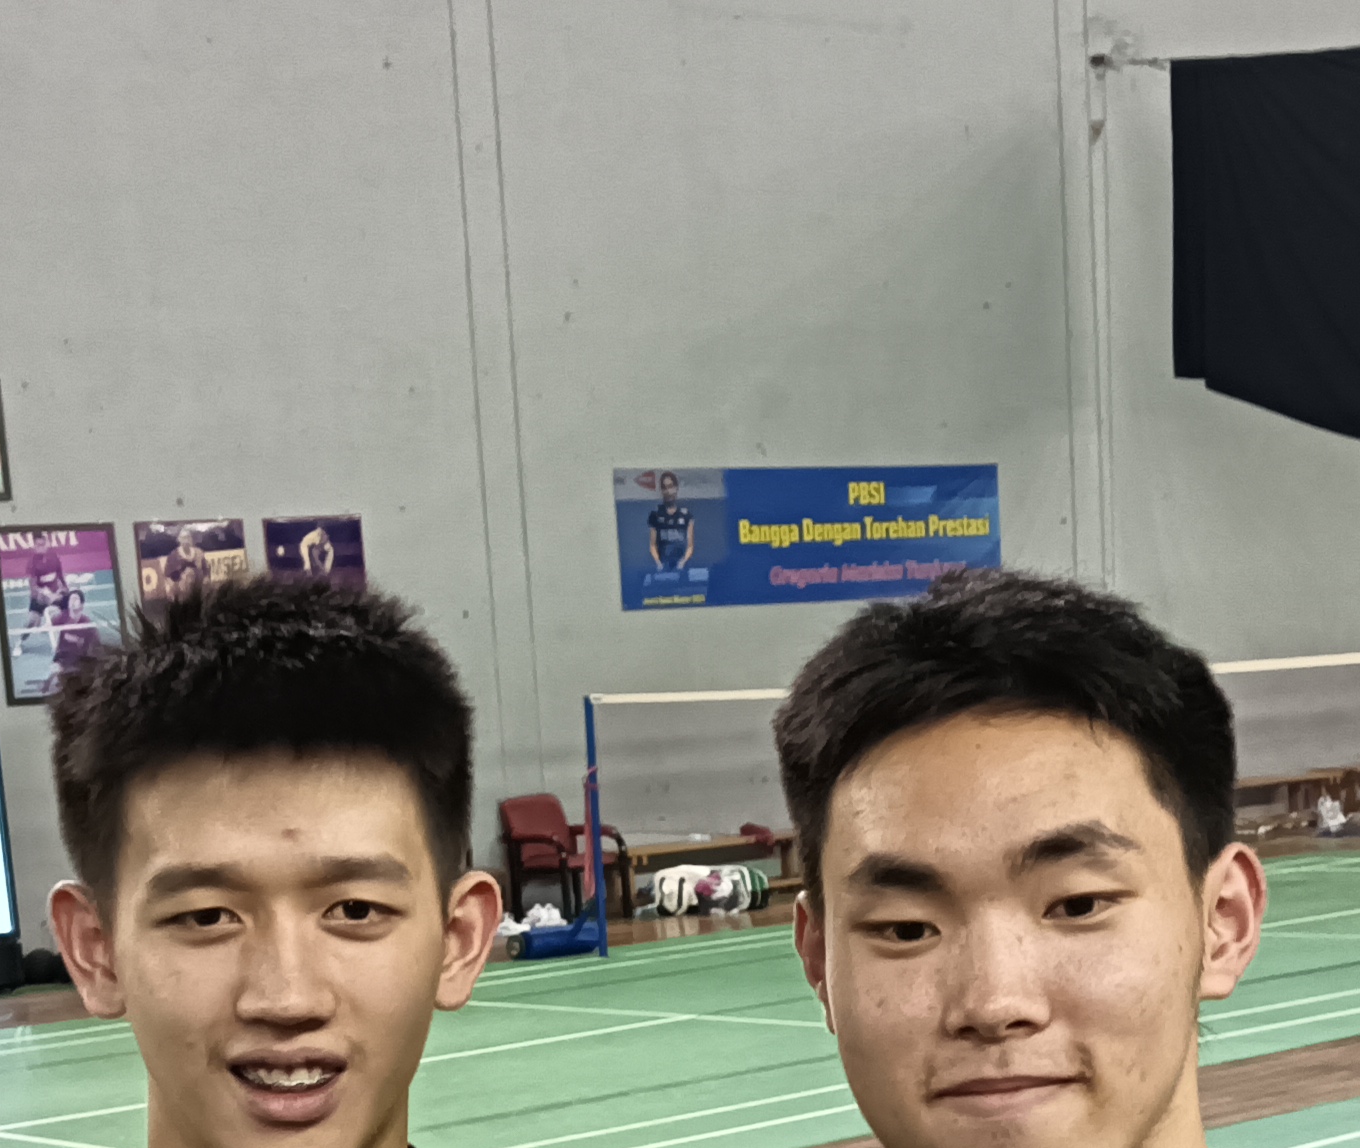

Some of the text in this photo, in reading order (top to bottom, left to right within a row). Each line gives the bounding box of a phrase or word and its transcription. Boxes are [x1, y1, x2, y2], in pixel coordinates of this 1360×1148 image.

[847, 481, 886, 506] PBSI
[739, 514, 990, 548] Bangga Dengan Torehan Prestasi
